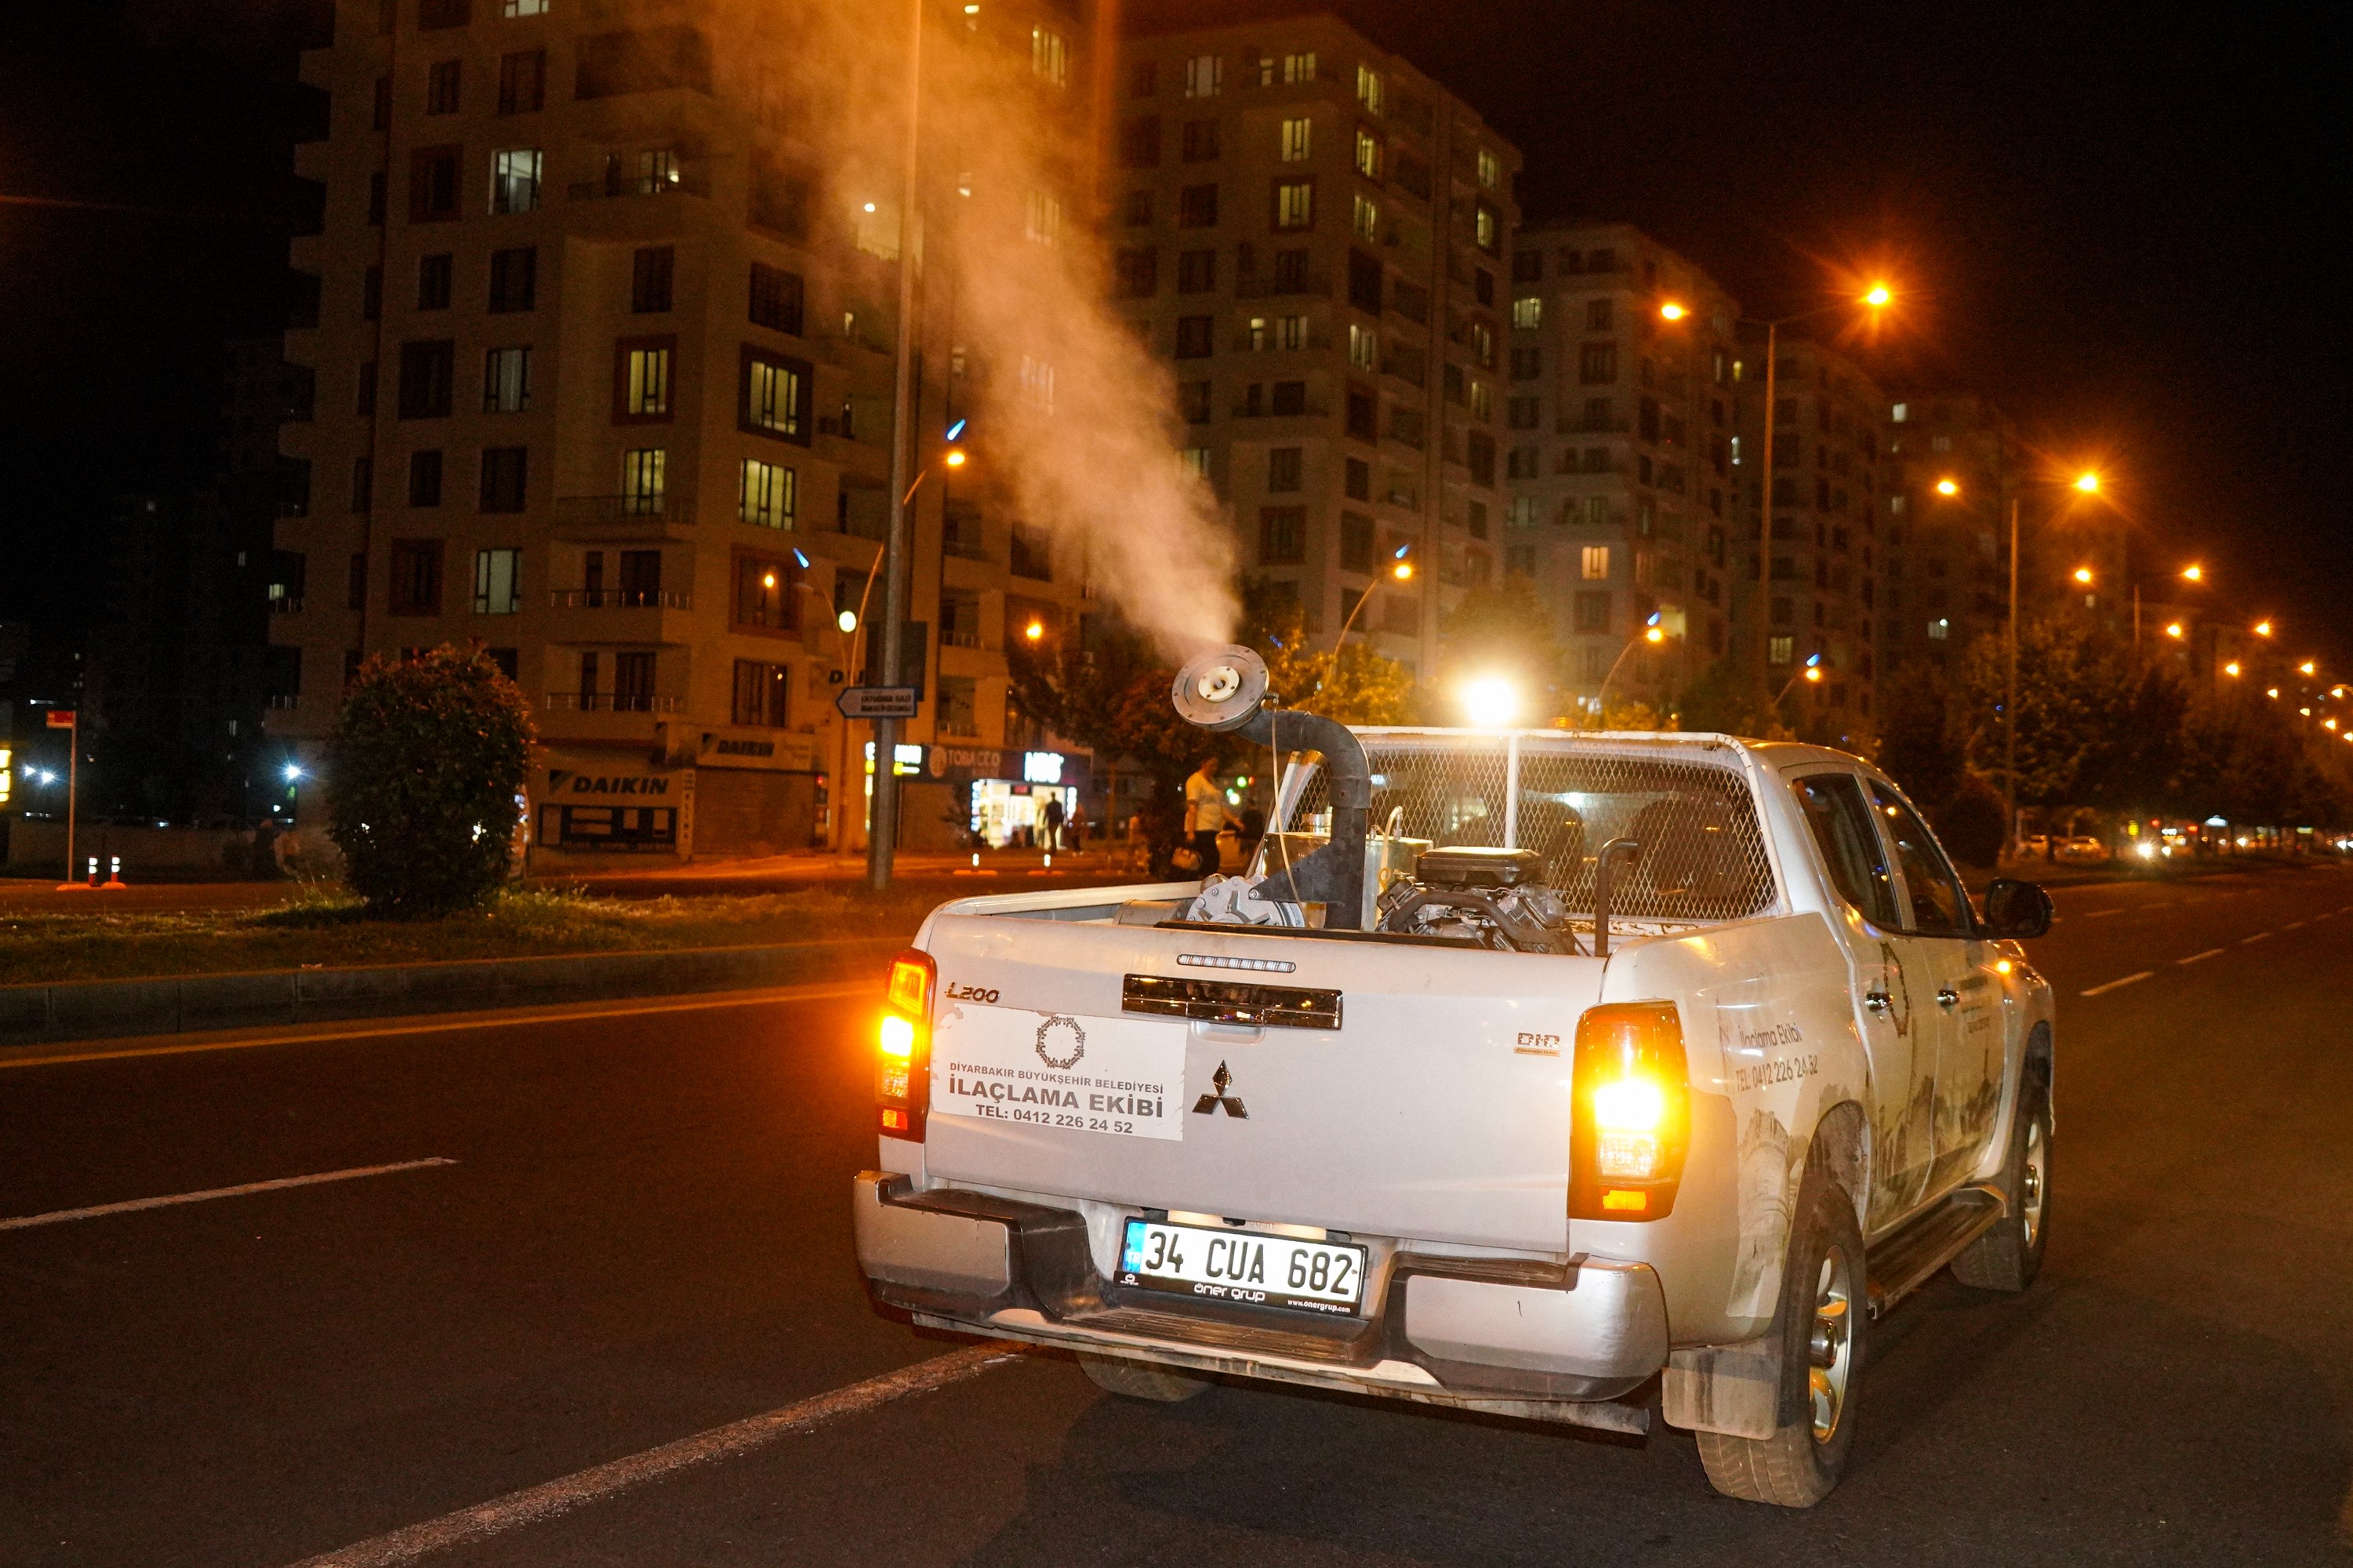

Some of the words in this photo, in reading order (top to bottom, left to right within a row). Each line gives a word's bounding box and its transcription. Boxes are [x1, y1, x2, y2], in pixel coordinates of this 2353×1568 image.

[572, 775, 670, 794] DAIKIN
[946, 982, 1000, 1004] L200
[1776, 1022, 1803, 1045] Ekibi
[950, 1062, 1015, 1079] DİYARBAKIR
[1019, 1069, 1091, 1087] BÜYÜKŞEHİR
[1095, 1078, 1164, 1094] BELEDİYESİ
[1752, 1063, 1774, 1088] 0412
[1774, 1059, 1793, 1083] 226
[950, 1076, 1079, 1109] İLAÇLAMA
[1089, 1093, 1164, 1118] EKİBİ
[975, 1104, 1008, 1120] TEL:
[1013, 1109, 1051, 1124] 0412
[1055, 1114, 1084, 1129] 226
[1089, 1118, 1109, 1132] 24
[1113, 1120, 1133, 1134] 52
[1145, 1231, 1184, 1274] 34
[1205, 1239, 1265, 1284] CUA
[1287, 1248, 1353, 1295] 682
[1230, 1287, 1266, 1302] grup
[1287, 1299, 1351, 1313] www.onergrup.com
